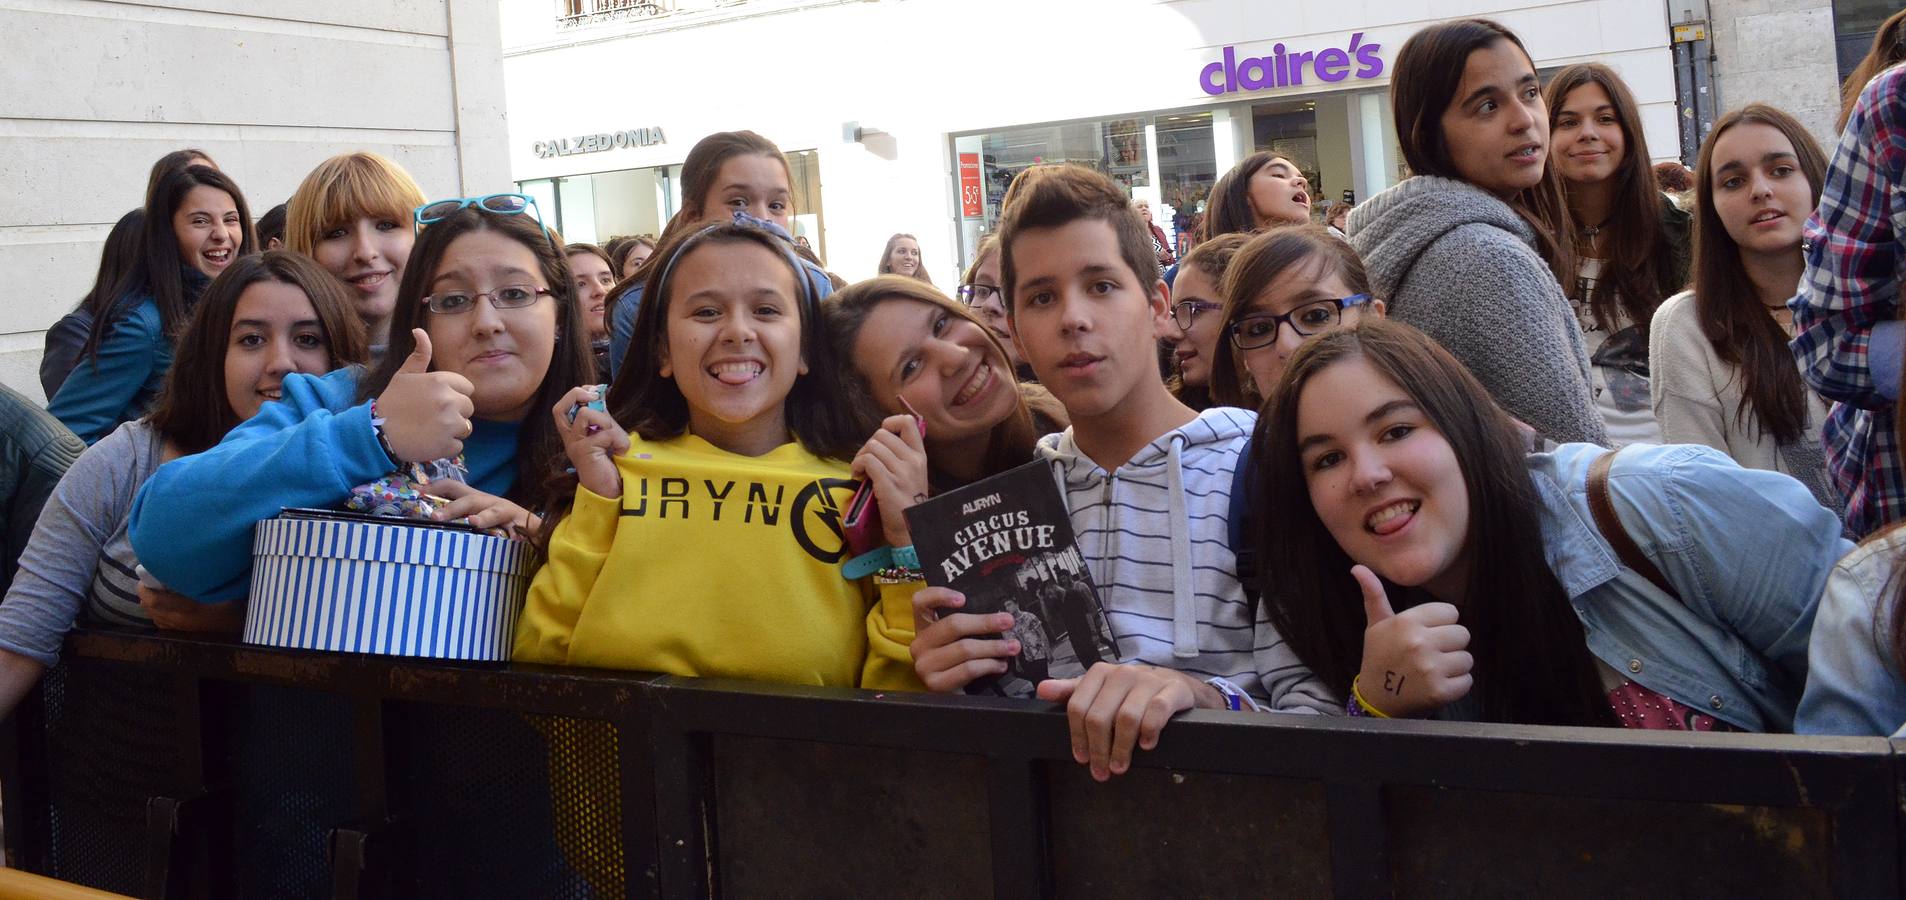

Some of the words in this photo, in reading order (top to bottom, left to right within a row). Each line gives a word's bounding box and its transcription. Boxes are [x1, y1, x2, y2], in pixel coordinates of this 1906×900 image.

[1200, 32, 1384, 96] claire's
[532, 126, 666, 159] CALZEDONIA
[619, 477, 785, 526] URYN
[962, 492, 1002, 516] AURYN
[954, 510, 1030, 546] CIRCUS
[940, 525, 1056, 583] AVENUE
